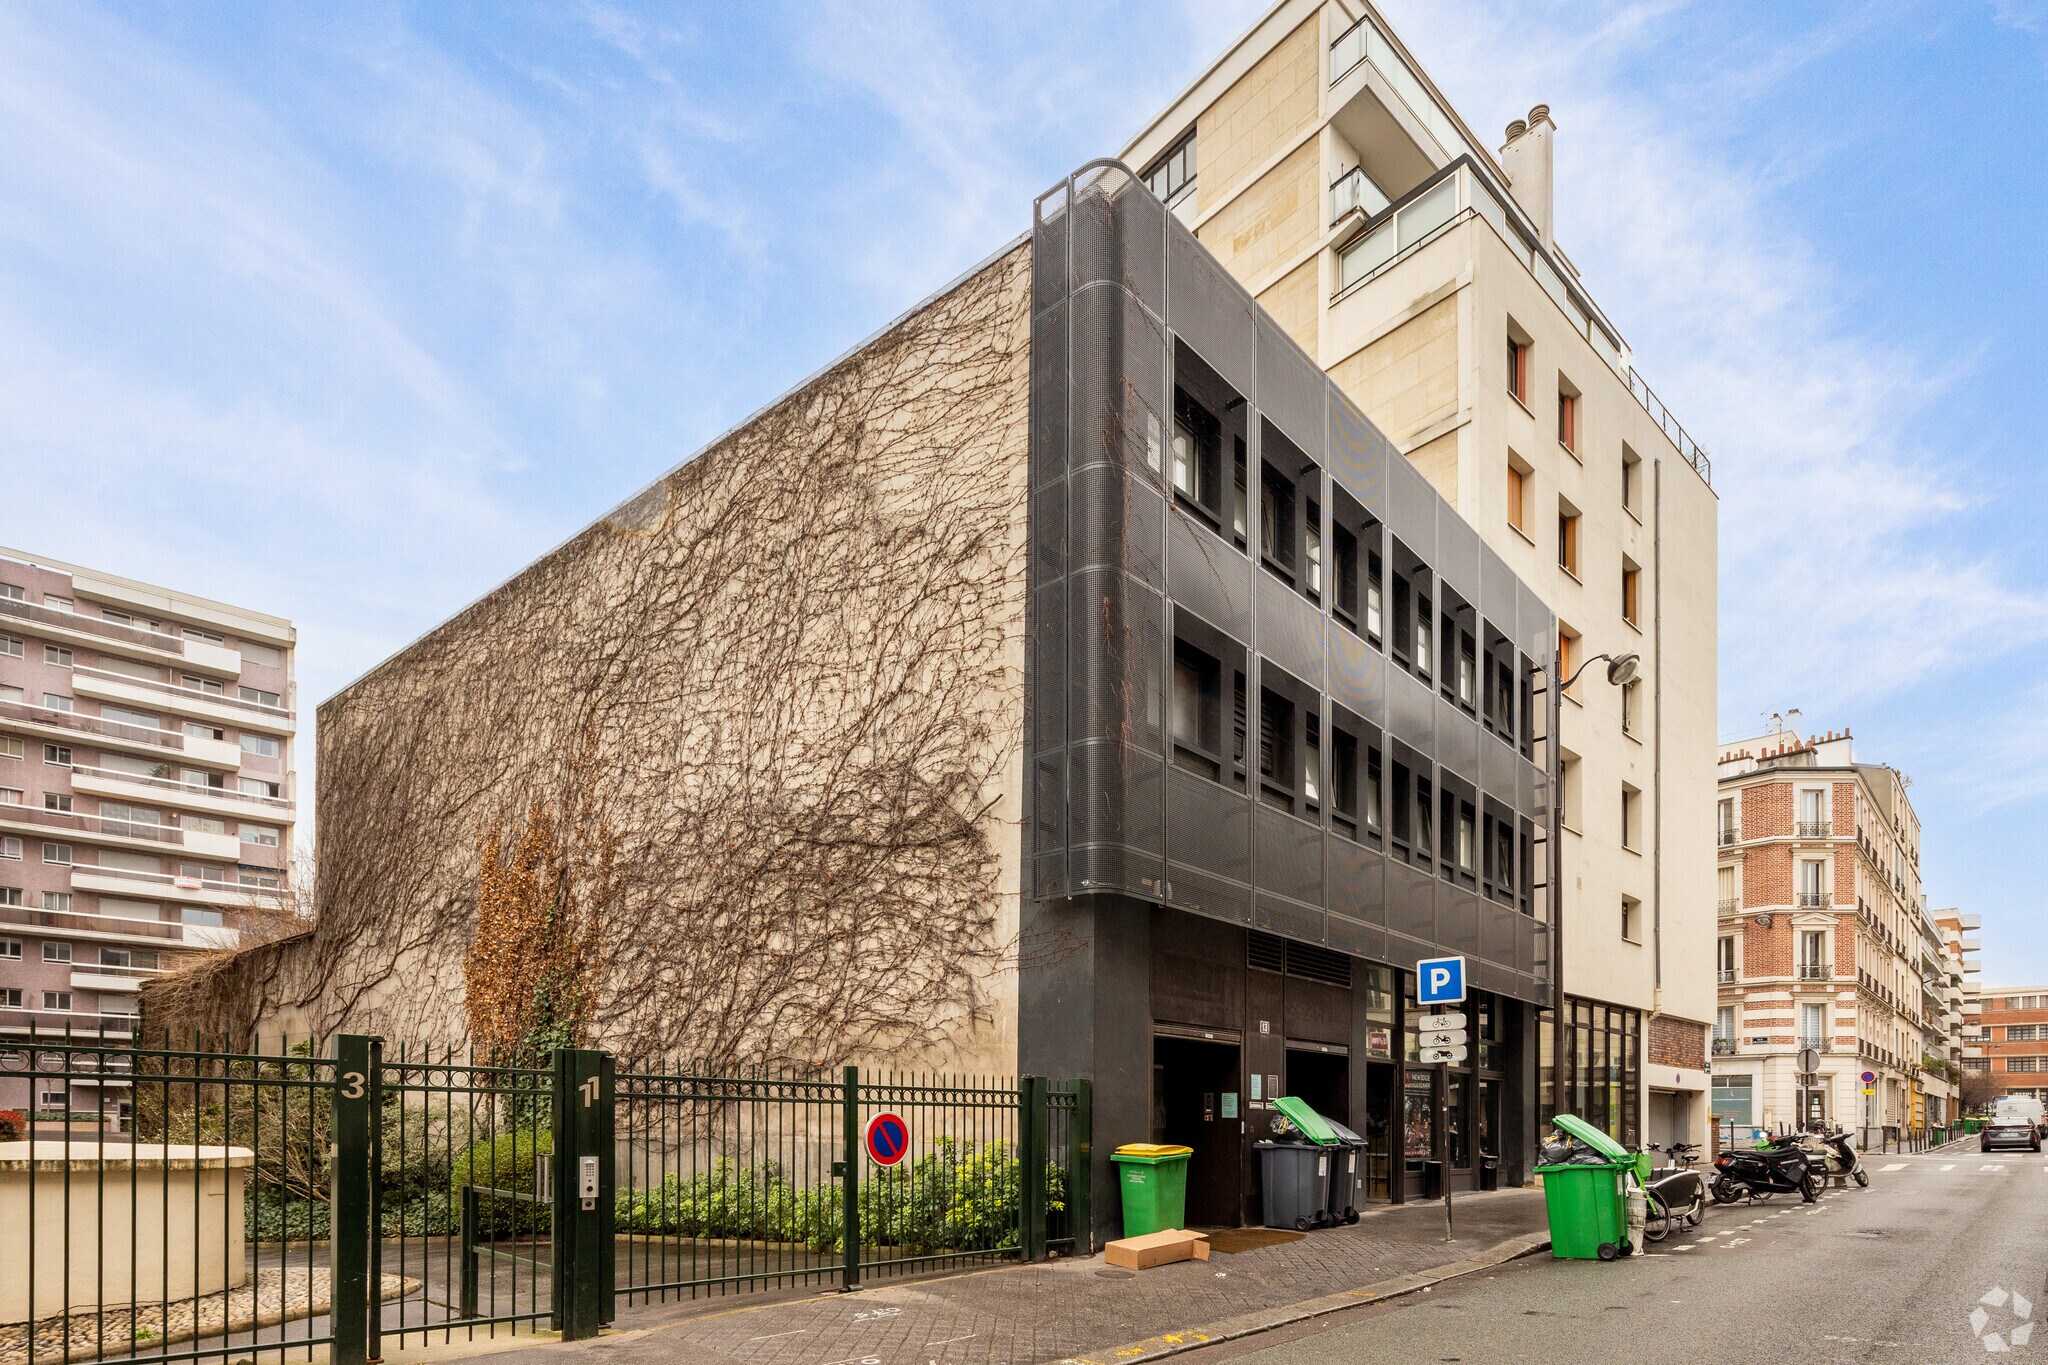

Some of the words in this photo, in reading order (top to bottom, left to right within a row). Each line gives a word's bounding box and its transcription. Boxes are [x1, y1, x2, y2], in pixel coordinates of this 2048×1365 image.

[1430, 967, 1451, 995] P
[341, 1071, 365, 1099] 3
[578, 1075, 600, 1108] 11
